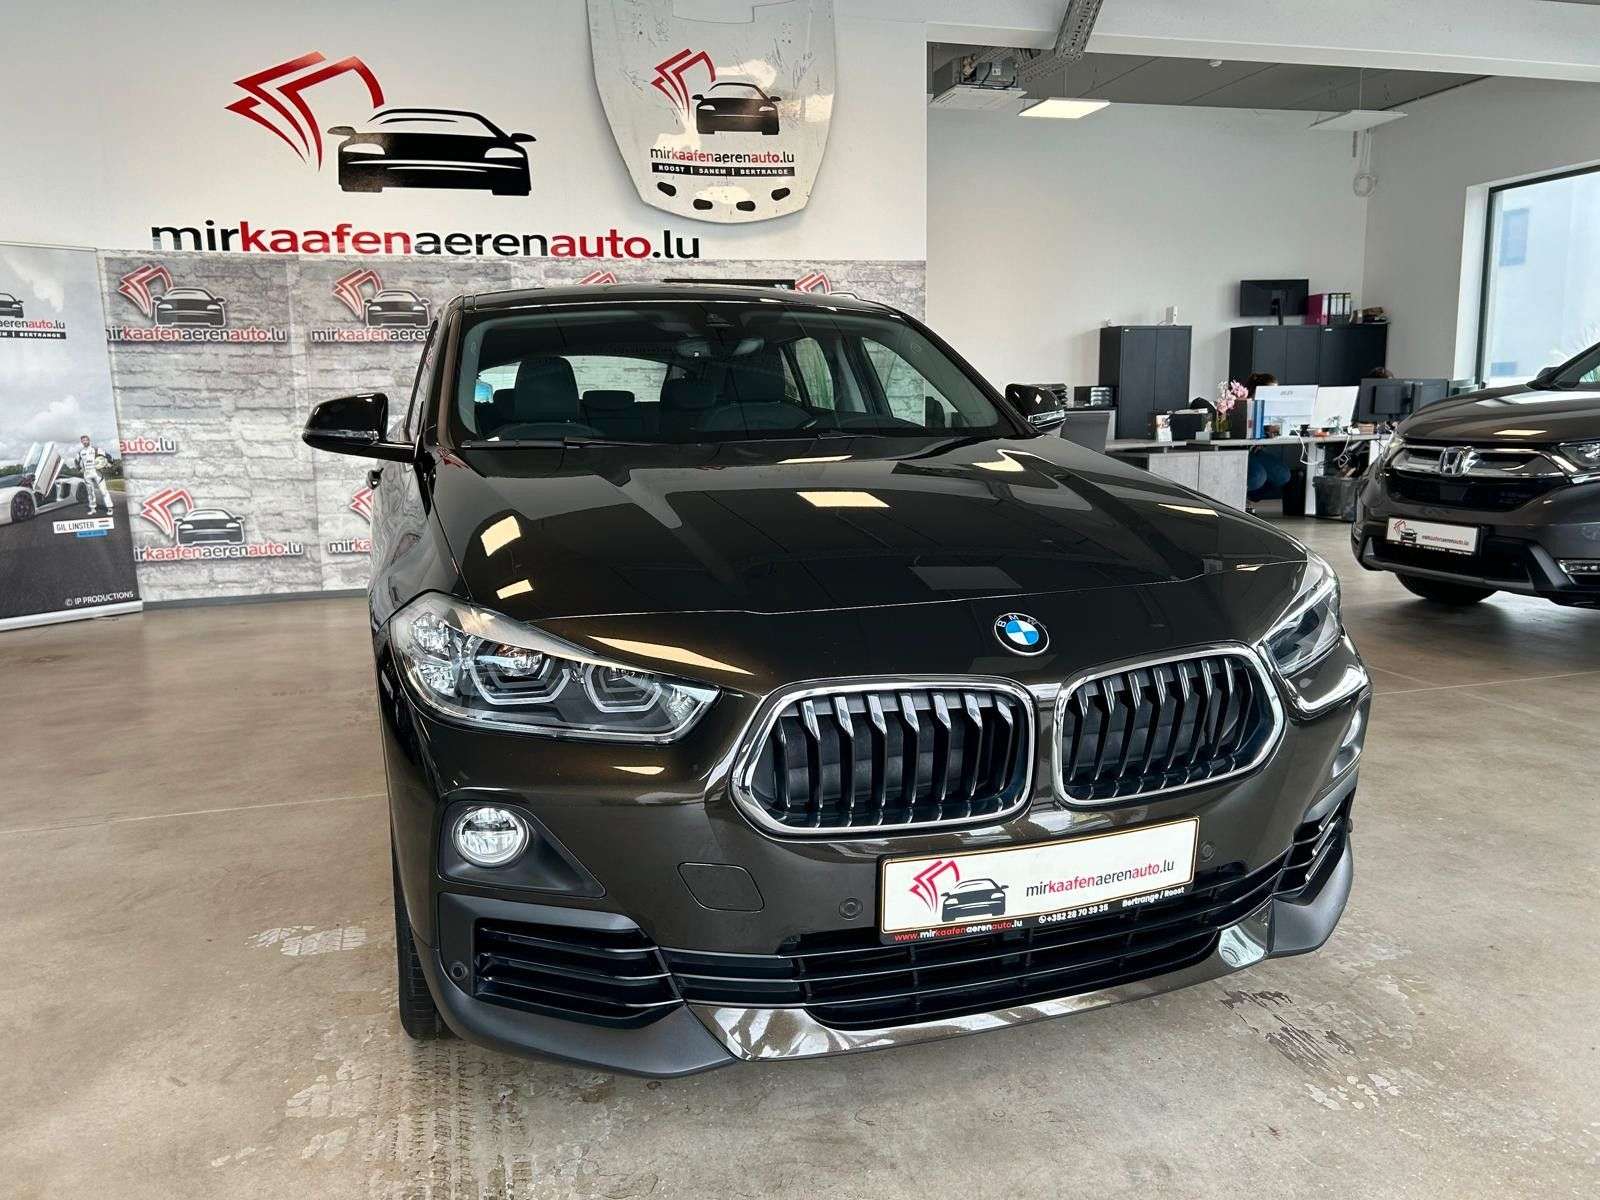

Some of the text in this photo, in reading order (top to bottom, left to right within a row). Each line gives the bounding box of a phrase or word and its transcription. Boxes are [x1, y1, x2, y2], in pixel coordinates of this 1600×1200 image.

[650, 147, 795, 163] mirkaafenaerenauto.lu
[658, 165, 685, 173] ROOST
[699, 167, 727, 175] SANEM
[151, 220, 700, 259] mirkaafenaerenauto.lu
[74, 597, 82, 605] IP
[83, 591, 134, 604] PRODUCTIONS
[997, 614, 1038, 628] BMW
[1026, 859, 1175, 897] mirkaafenaerenauto.lu
[1121, 892, 1160, 907] Bertrange
[1078, 908, 1088, 917] 70
[894, 919, 1023, 942] www.mirkaafenaerenauto.lu
